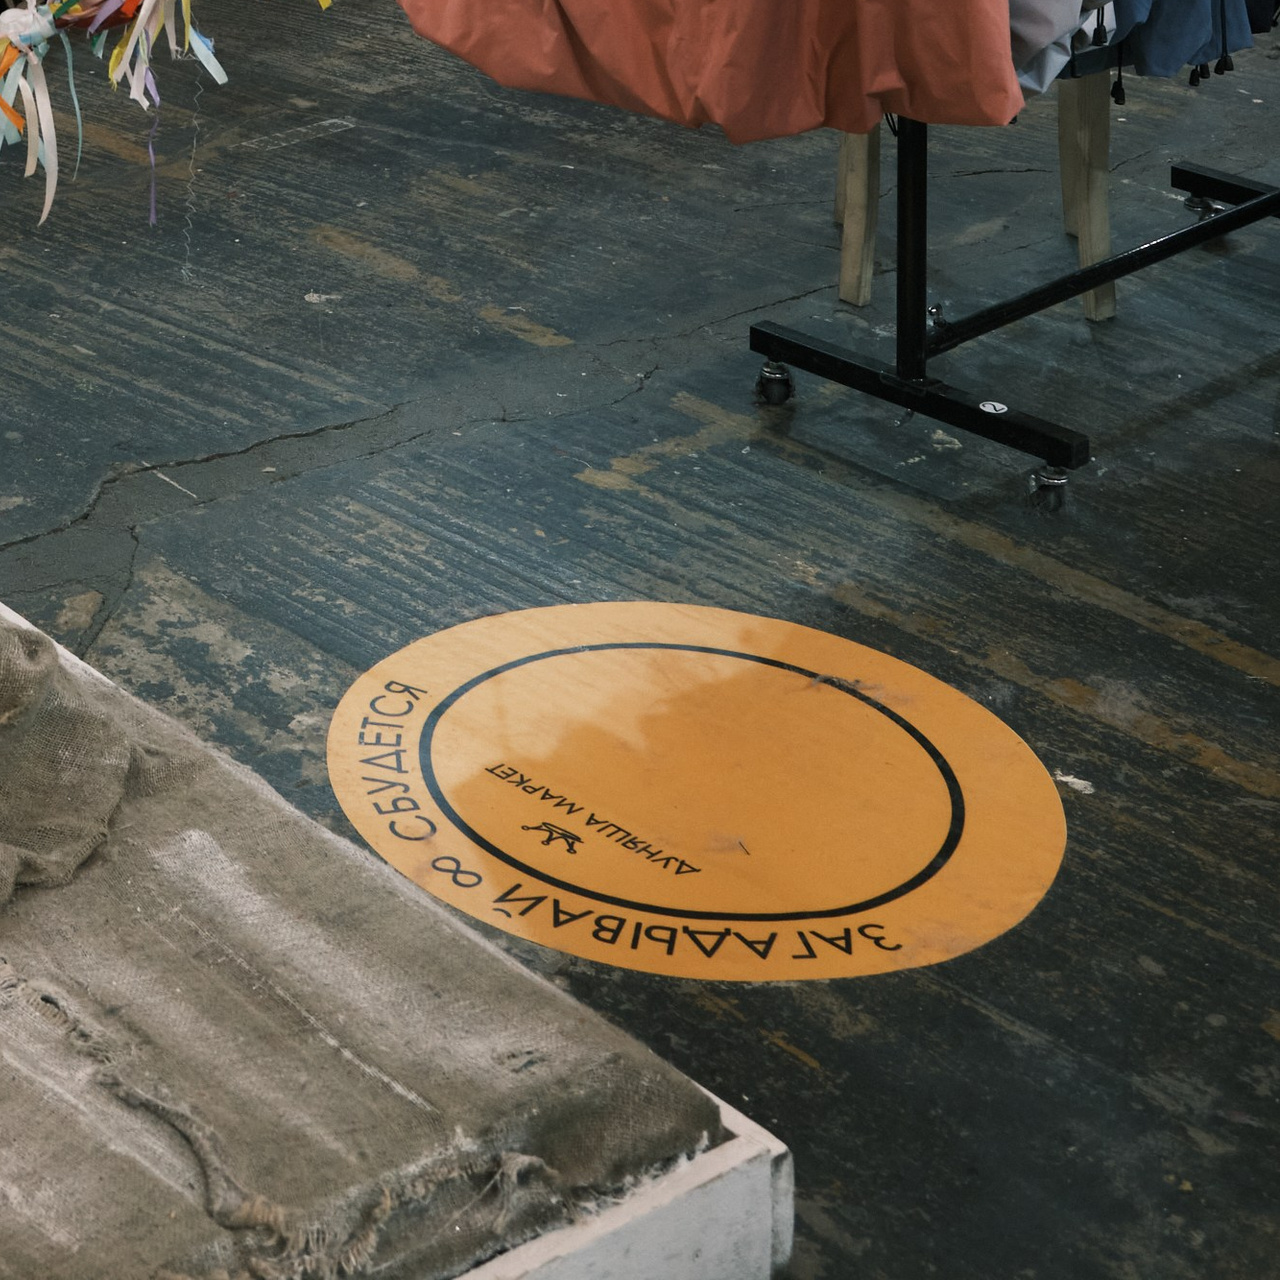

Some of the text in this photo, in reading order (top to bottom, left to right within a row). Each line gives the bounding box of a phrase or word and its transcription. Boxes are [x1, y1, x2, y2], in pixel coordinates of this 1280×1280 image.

[358, 680, 904, 961] ЗАГАДЫВАЙ СБУДЕТСЯ
[484, 763, 702, 876] ДУНЯША МАРКЕТ
